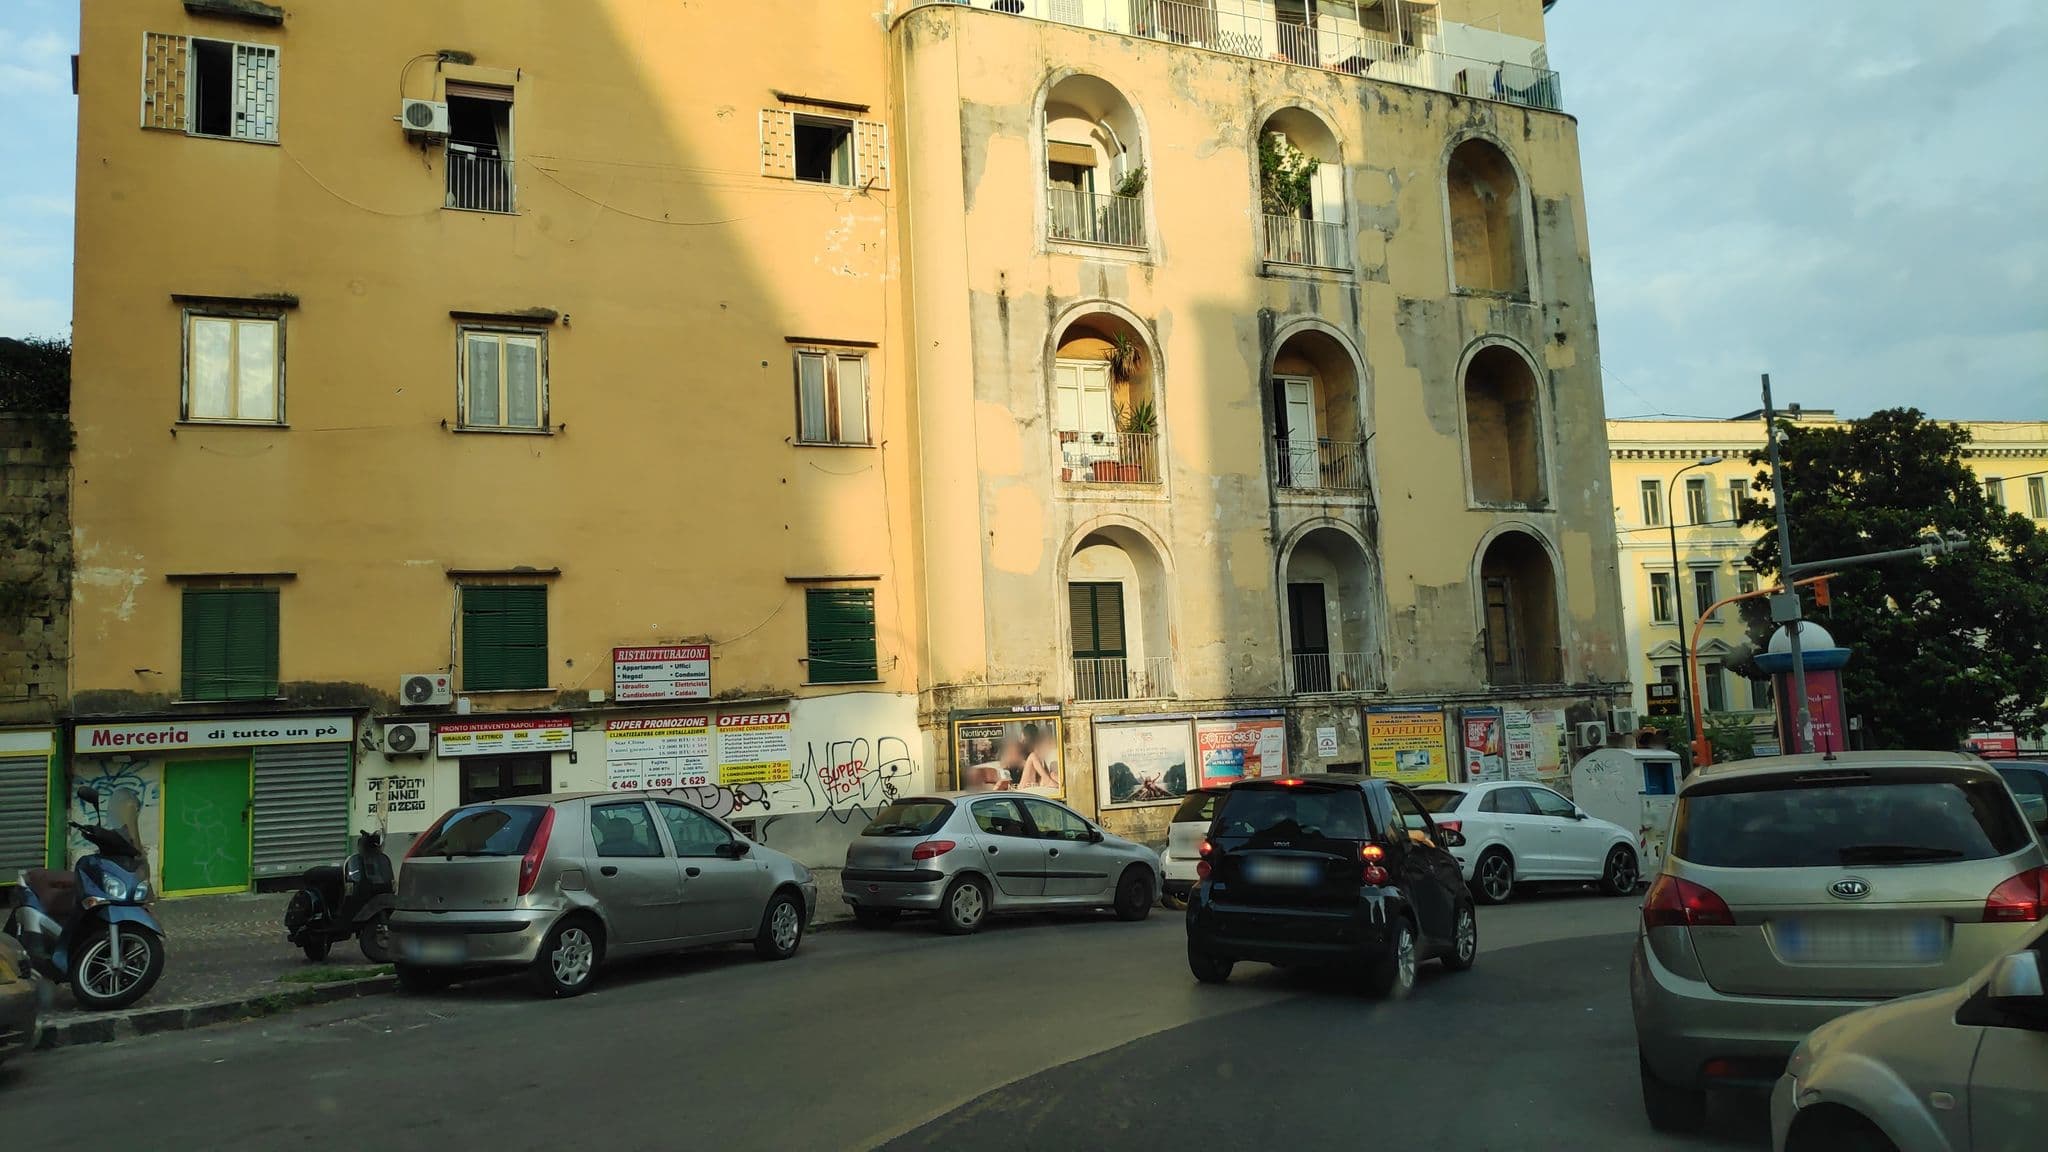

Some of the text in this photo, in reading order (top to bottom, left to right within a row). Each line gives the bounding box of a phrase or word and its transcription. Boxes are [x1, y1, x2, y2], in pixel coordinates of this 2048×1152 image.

[618, 649, 706, 660] RISTRUTTURAZIONI
[610, 718, 706, 729] SUPER PROMOZIONE
[720, 714, 787, 726] OFFERTA
[962, 729, 1002, 738] Nottingham
[1371, 725, 1442, 735] D'AFFLITTO
[92, 725, 337, 746] Merceria di tutto un pò
[819, 760, 869, 784] SUPER
[612, 780, 638, 789] € 449
[647, 778, 672, 787] € 699
[681, 776, 706, 785] € 629
[1836, 883, 1863, 893] KIA
